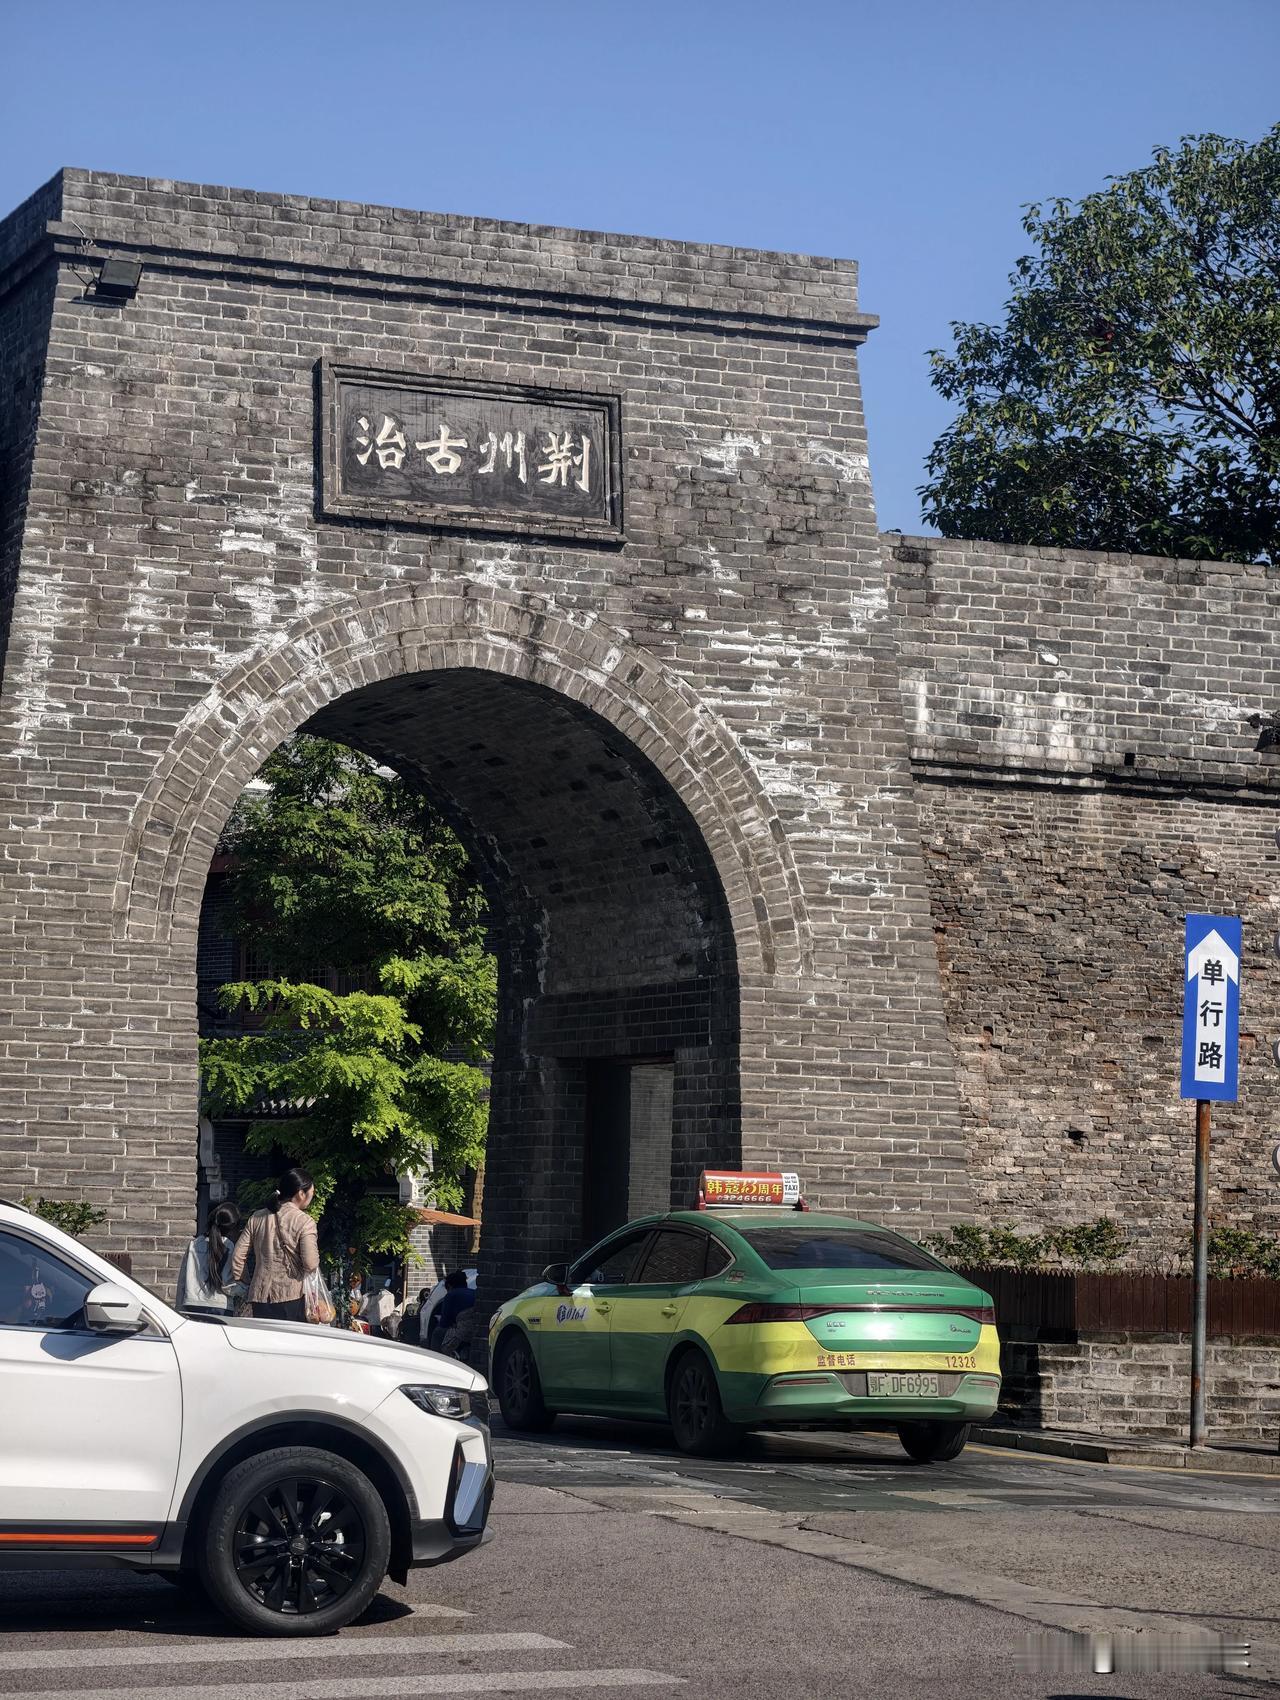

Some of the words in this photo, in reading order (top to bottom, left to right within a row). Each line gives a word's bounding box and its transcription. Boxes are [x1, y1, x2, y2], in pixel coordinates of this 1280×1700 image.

[1198, 958, 1225, 1070] 单行路
[816, 1354, 856, 1367] 监督电话
[945, 1355, 976, 1369] 12328
